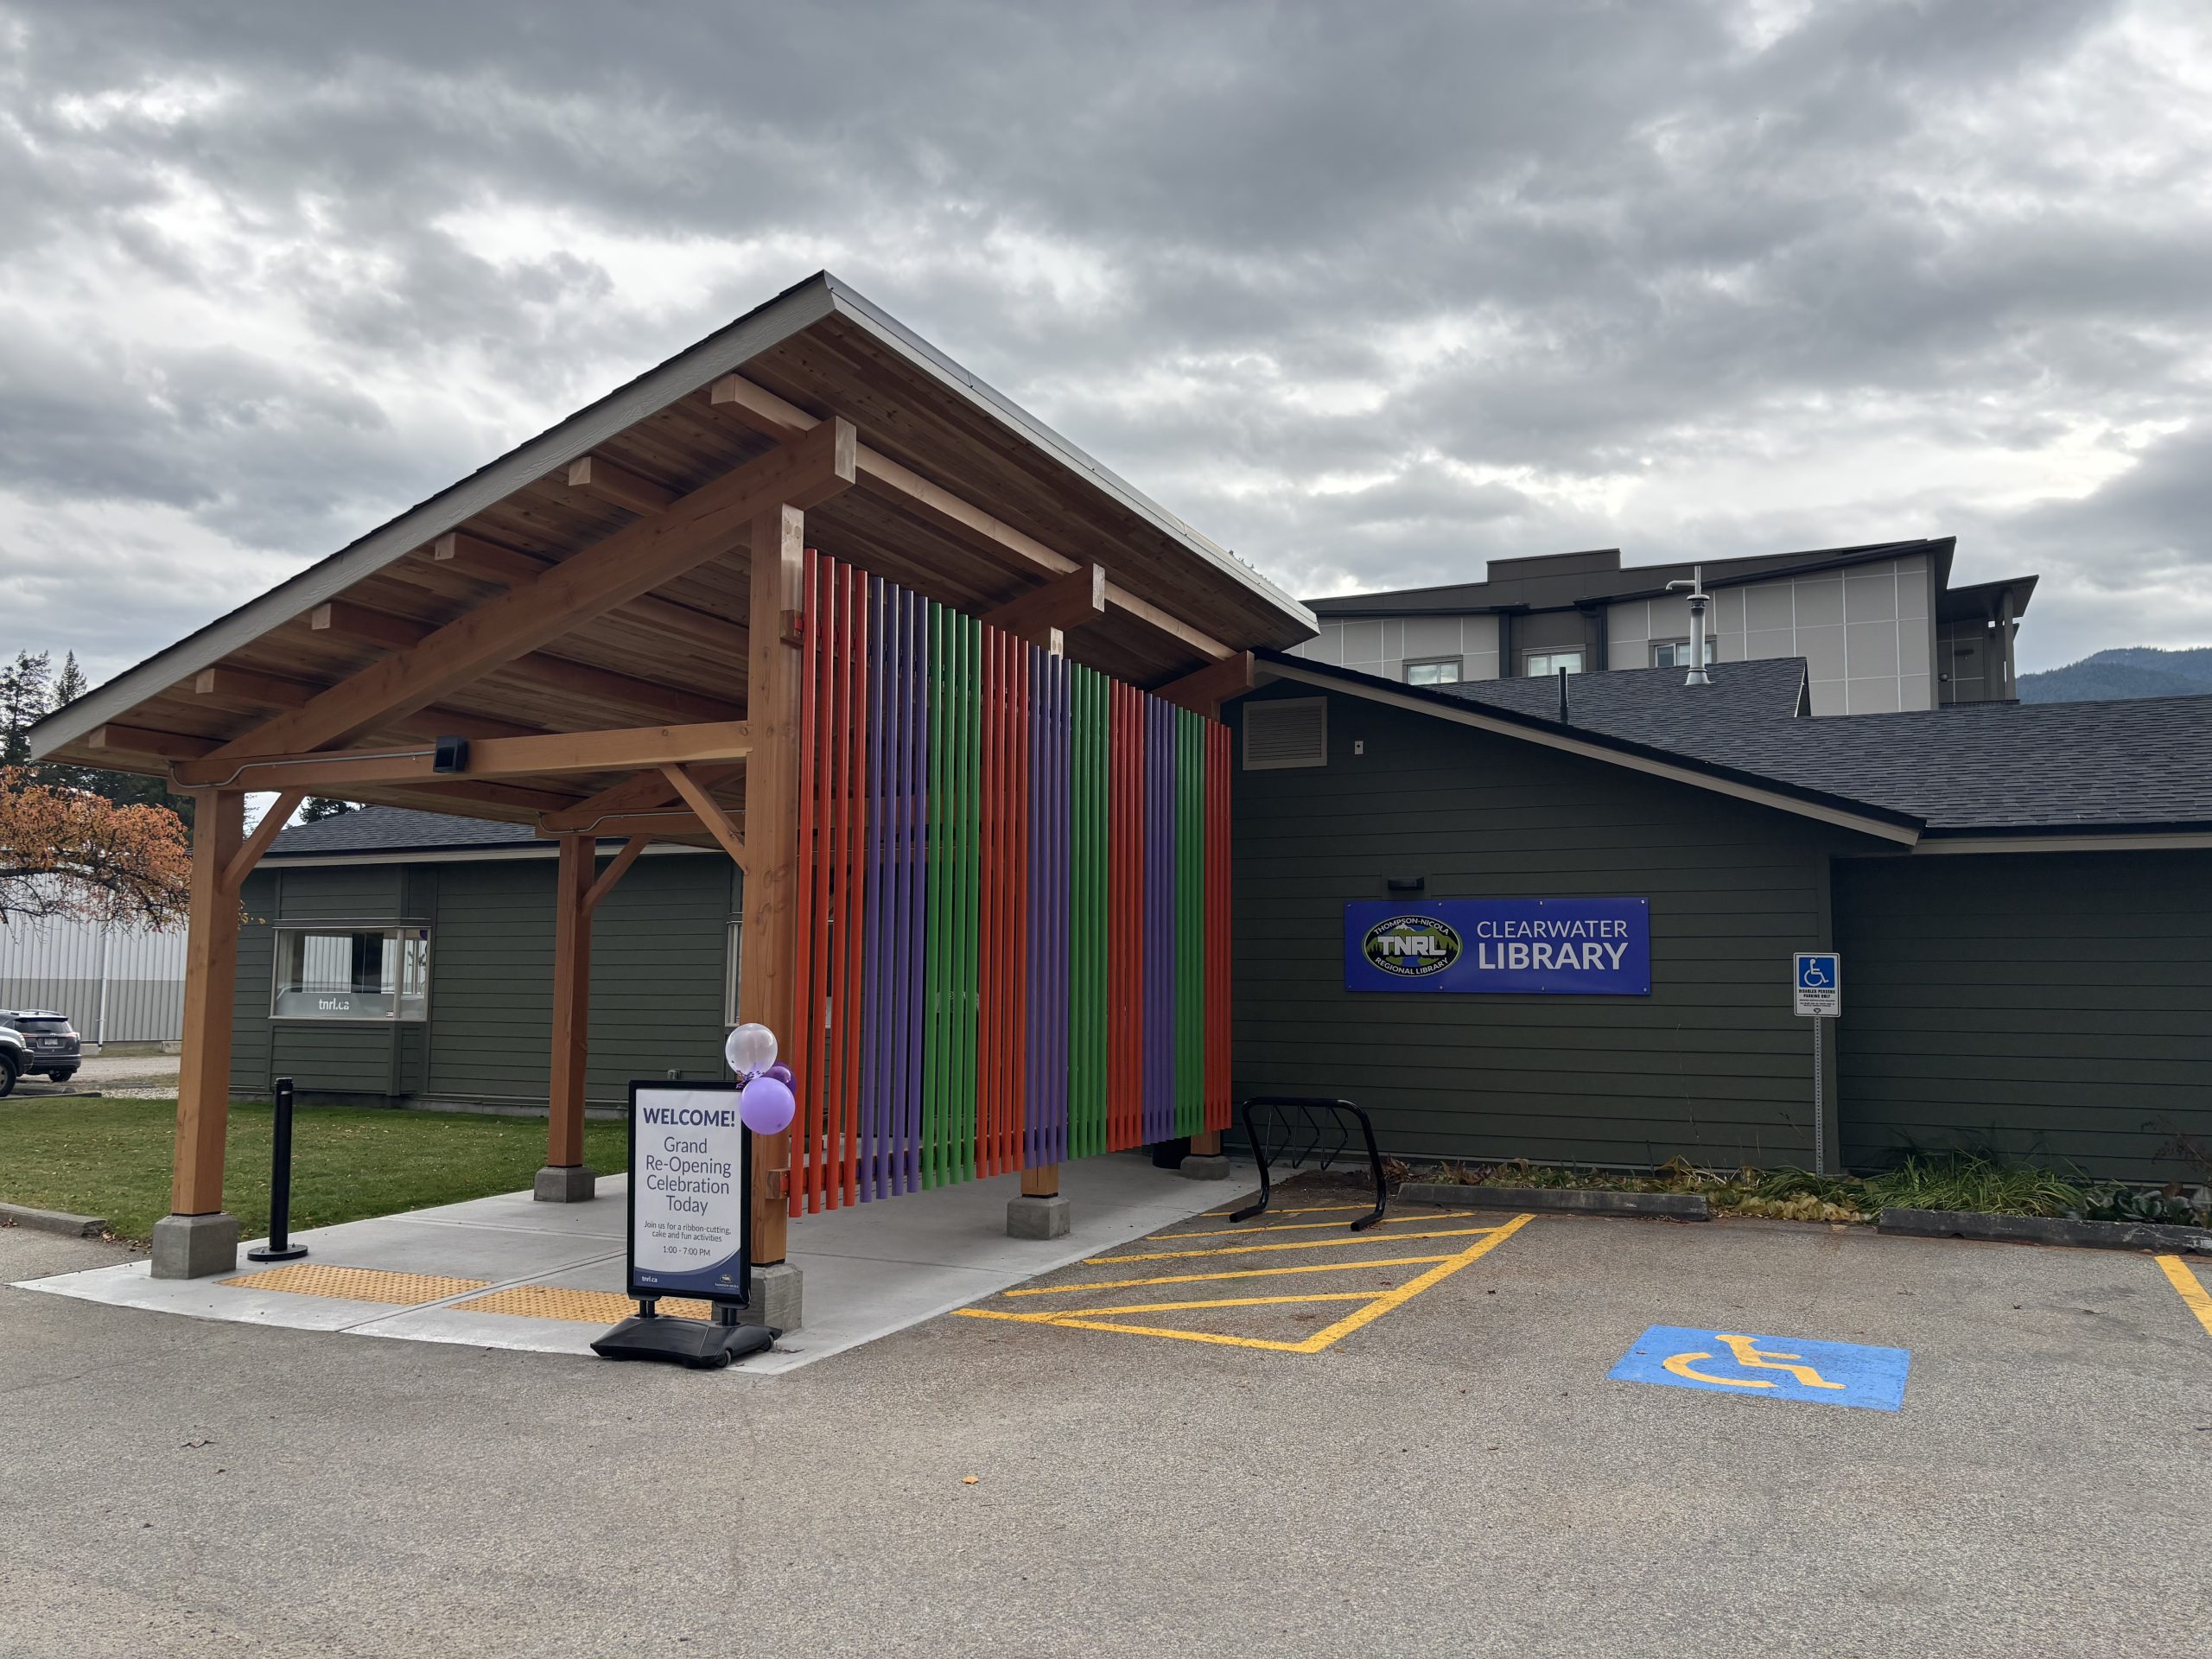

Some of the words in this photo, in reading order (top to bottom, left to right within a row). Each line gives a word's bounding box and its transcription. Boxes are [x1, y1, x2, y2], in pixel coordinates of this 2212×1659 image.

[1374, 918, 1449, 935] THOMPSON-NICOLA
[1477, 920, 1628, 938] CLEARWATER
[1377, 936, 1446, 956] TNRL
[1478, 942, 1629, 969] LIBRARY
[1375, 957, 1415, 975] REGIONAL
[1415, 957, 1448, 975] LIBRARY
[643, 1107, 735, 1128] WELCOME!
[664, 1136, 707, 1154] Grand
[645, 1154, 732, 1178] Re-Opening
[646, 1174, 729, 1194] Celebration
[666, 1195, 709, 1216] Today
[644, 1220, 657, 1229] Join
[667, 1222, 677, 1230] for
[693, 1233, 722, 1243] activities
[683, 1247, 698, 1255] 7:00
